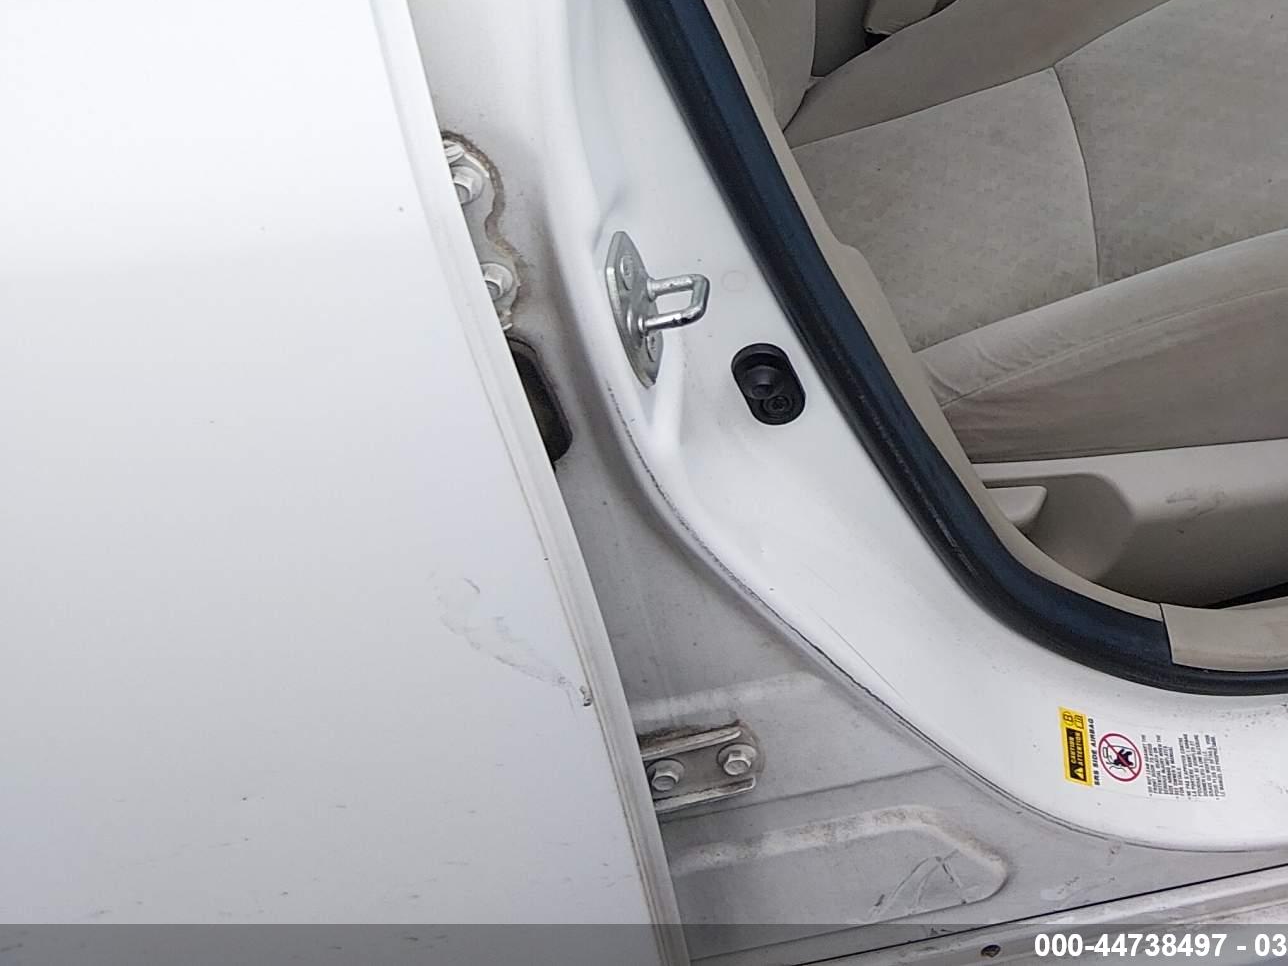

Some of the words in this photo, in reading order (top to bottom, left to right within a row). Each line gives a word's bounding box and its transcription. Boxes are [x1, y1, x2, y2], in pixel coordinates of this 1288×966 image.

[1088, 718, 1096, 747] AIRBAG
[1069, 736, 1077, 764] CAUTION
[1076, 732, 1084, 766] ATTENTION
